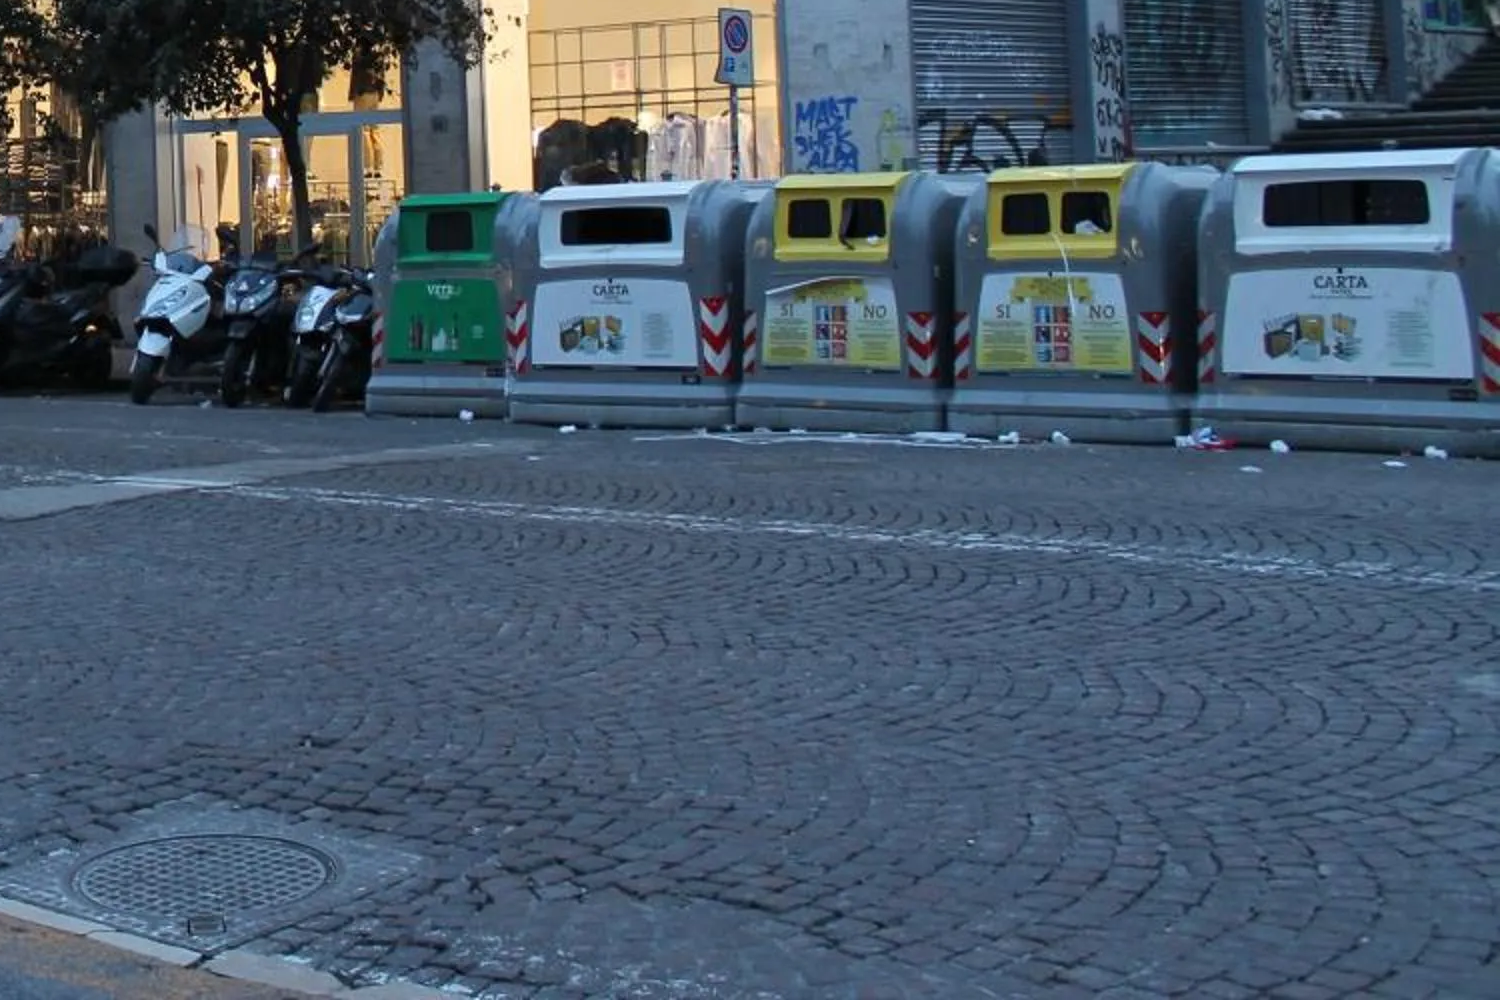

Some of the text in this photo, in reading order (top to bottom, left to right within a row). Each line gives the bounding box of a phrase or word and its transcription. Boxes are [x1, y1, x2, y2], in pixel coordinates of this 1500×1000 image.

[1313, 275, 1369, 289] CARTA
[863, 304, 887, 318] NO
[1088, 304, 1115, 319] NO
